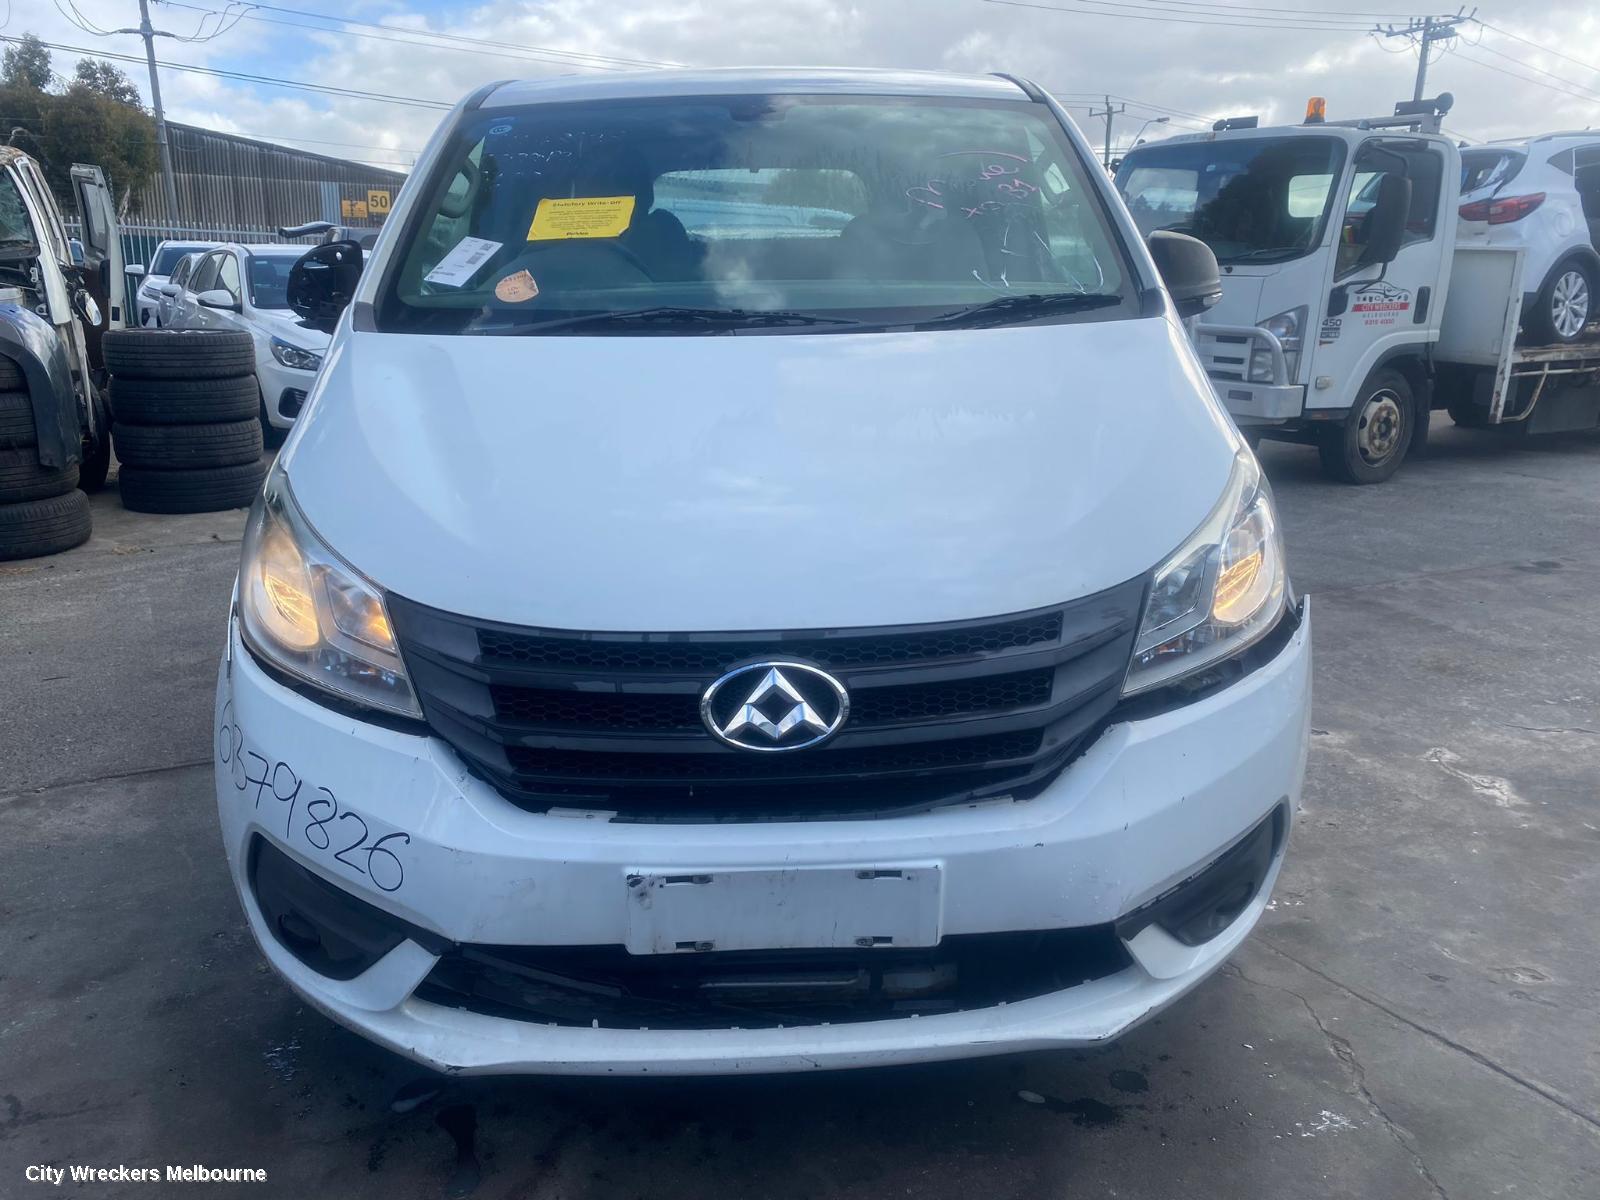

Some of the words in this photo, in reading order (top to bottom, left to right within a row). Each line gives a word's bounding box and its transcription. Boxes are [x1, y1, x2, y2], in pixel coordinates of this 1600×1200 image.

[370, 195, 388, 208] 50
[1362, 303, 1373, 311] CITY
[1322, 318, 1342, 327] 450
